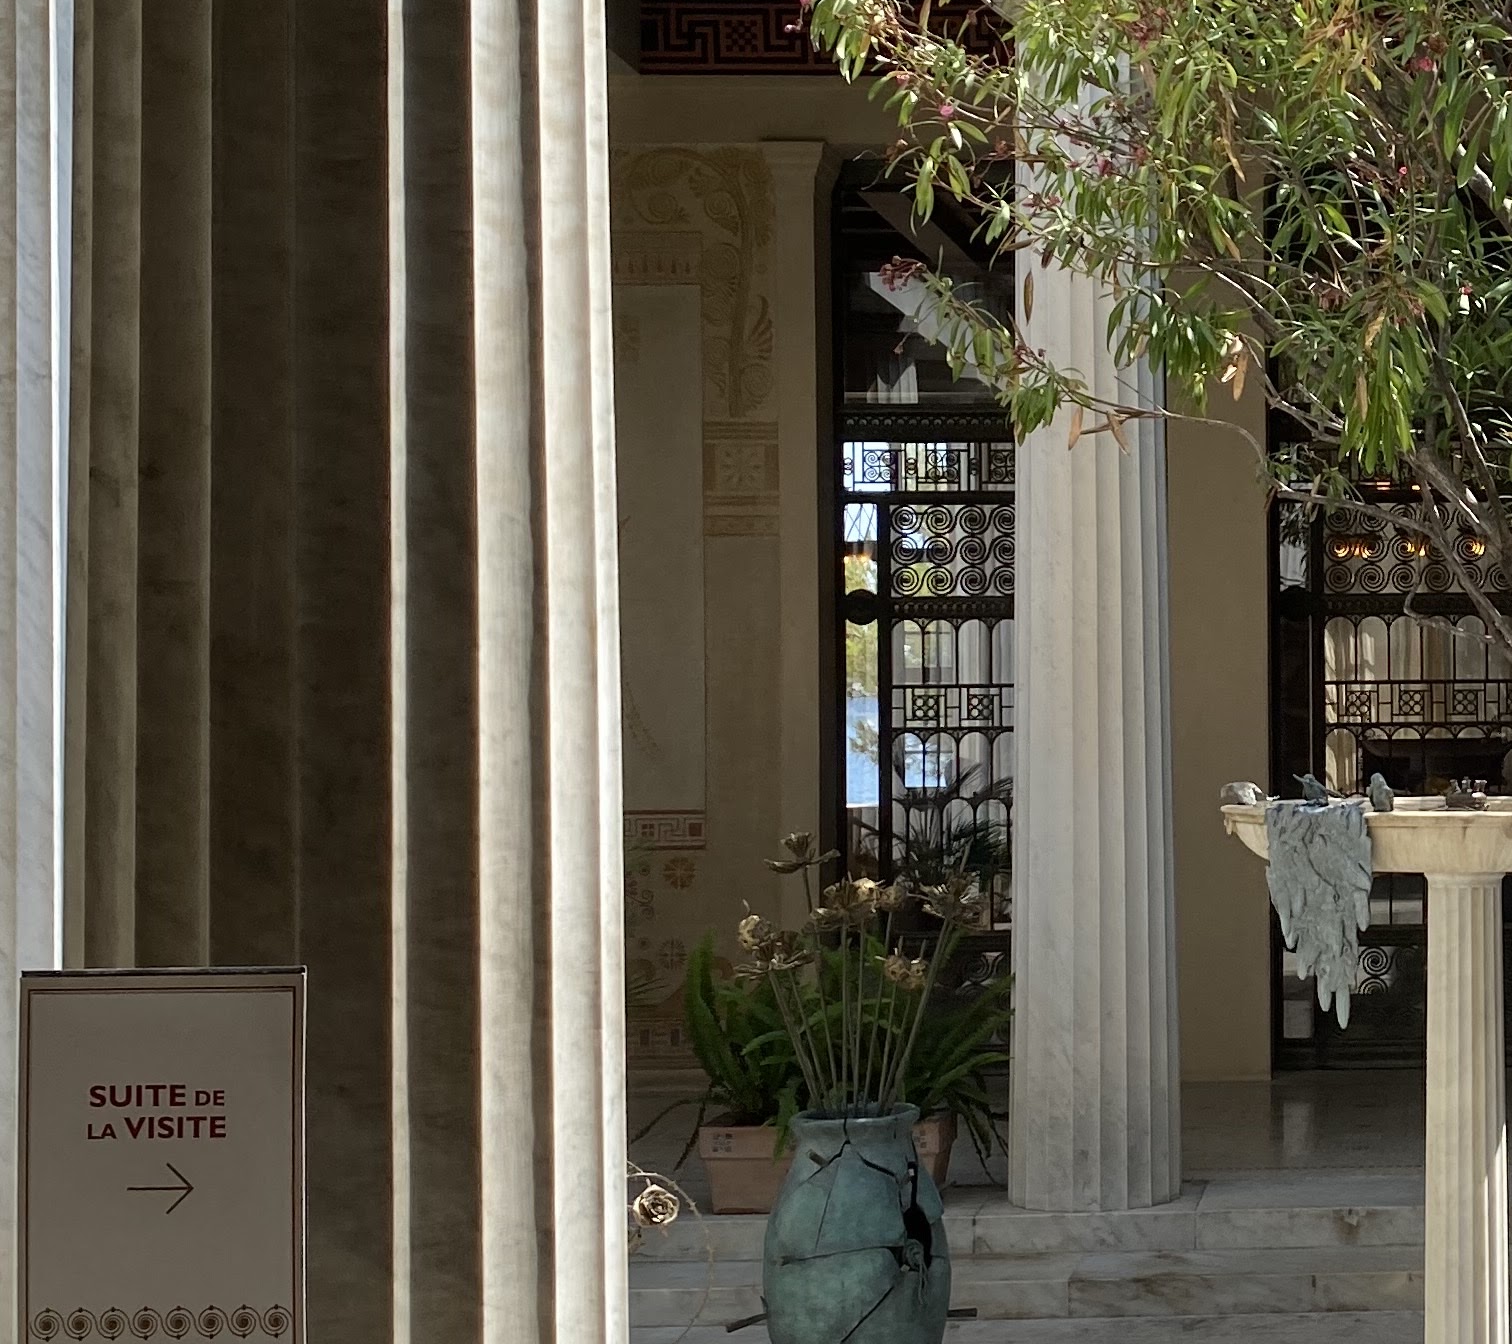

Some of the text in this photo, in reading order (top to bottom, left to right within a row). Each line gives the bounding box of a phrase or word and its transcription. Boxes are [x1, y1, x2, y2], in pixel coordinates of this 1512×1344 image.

[89, 1084, 225, 1107] SUITE DE
[87, 1115, 227, 1140] LA VISITE
